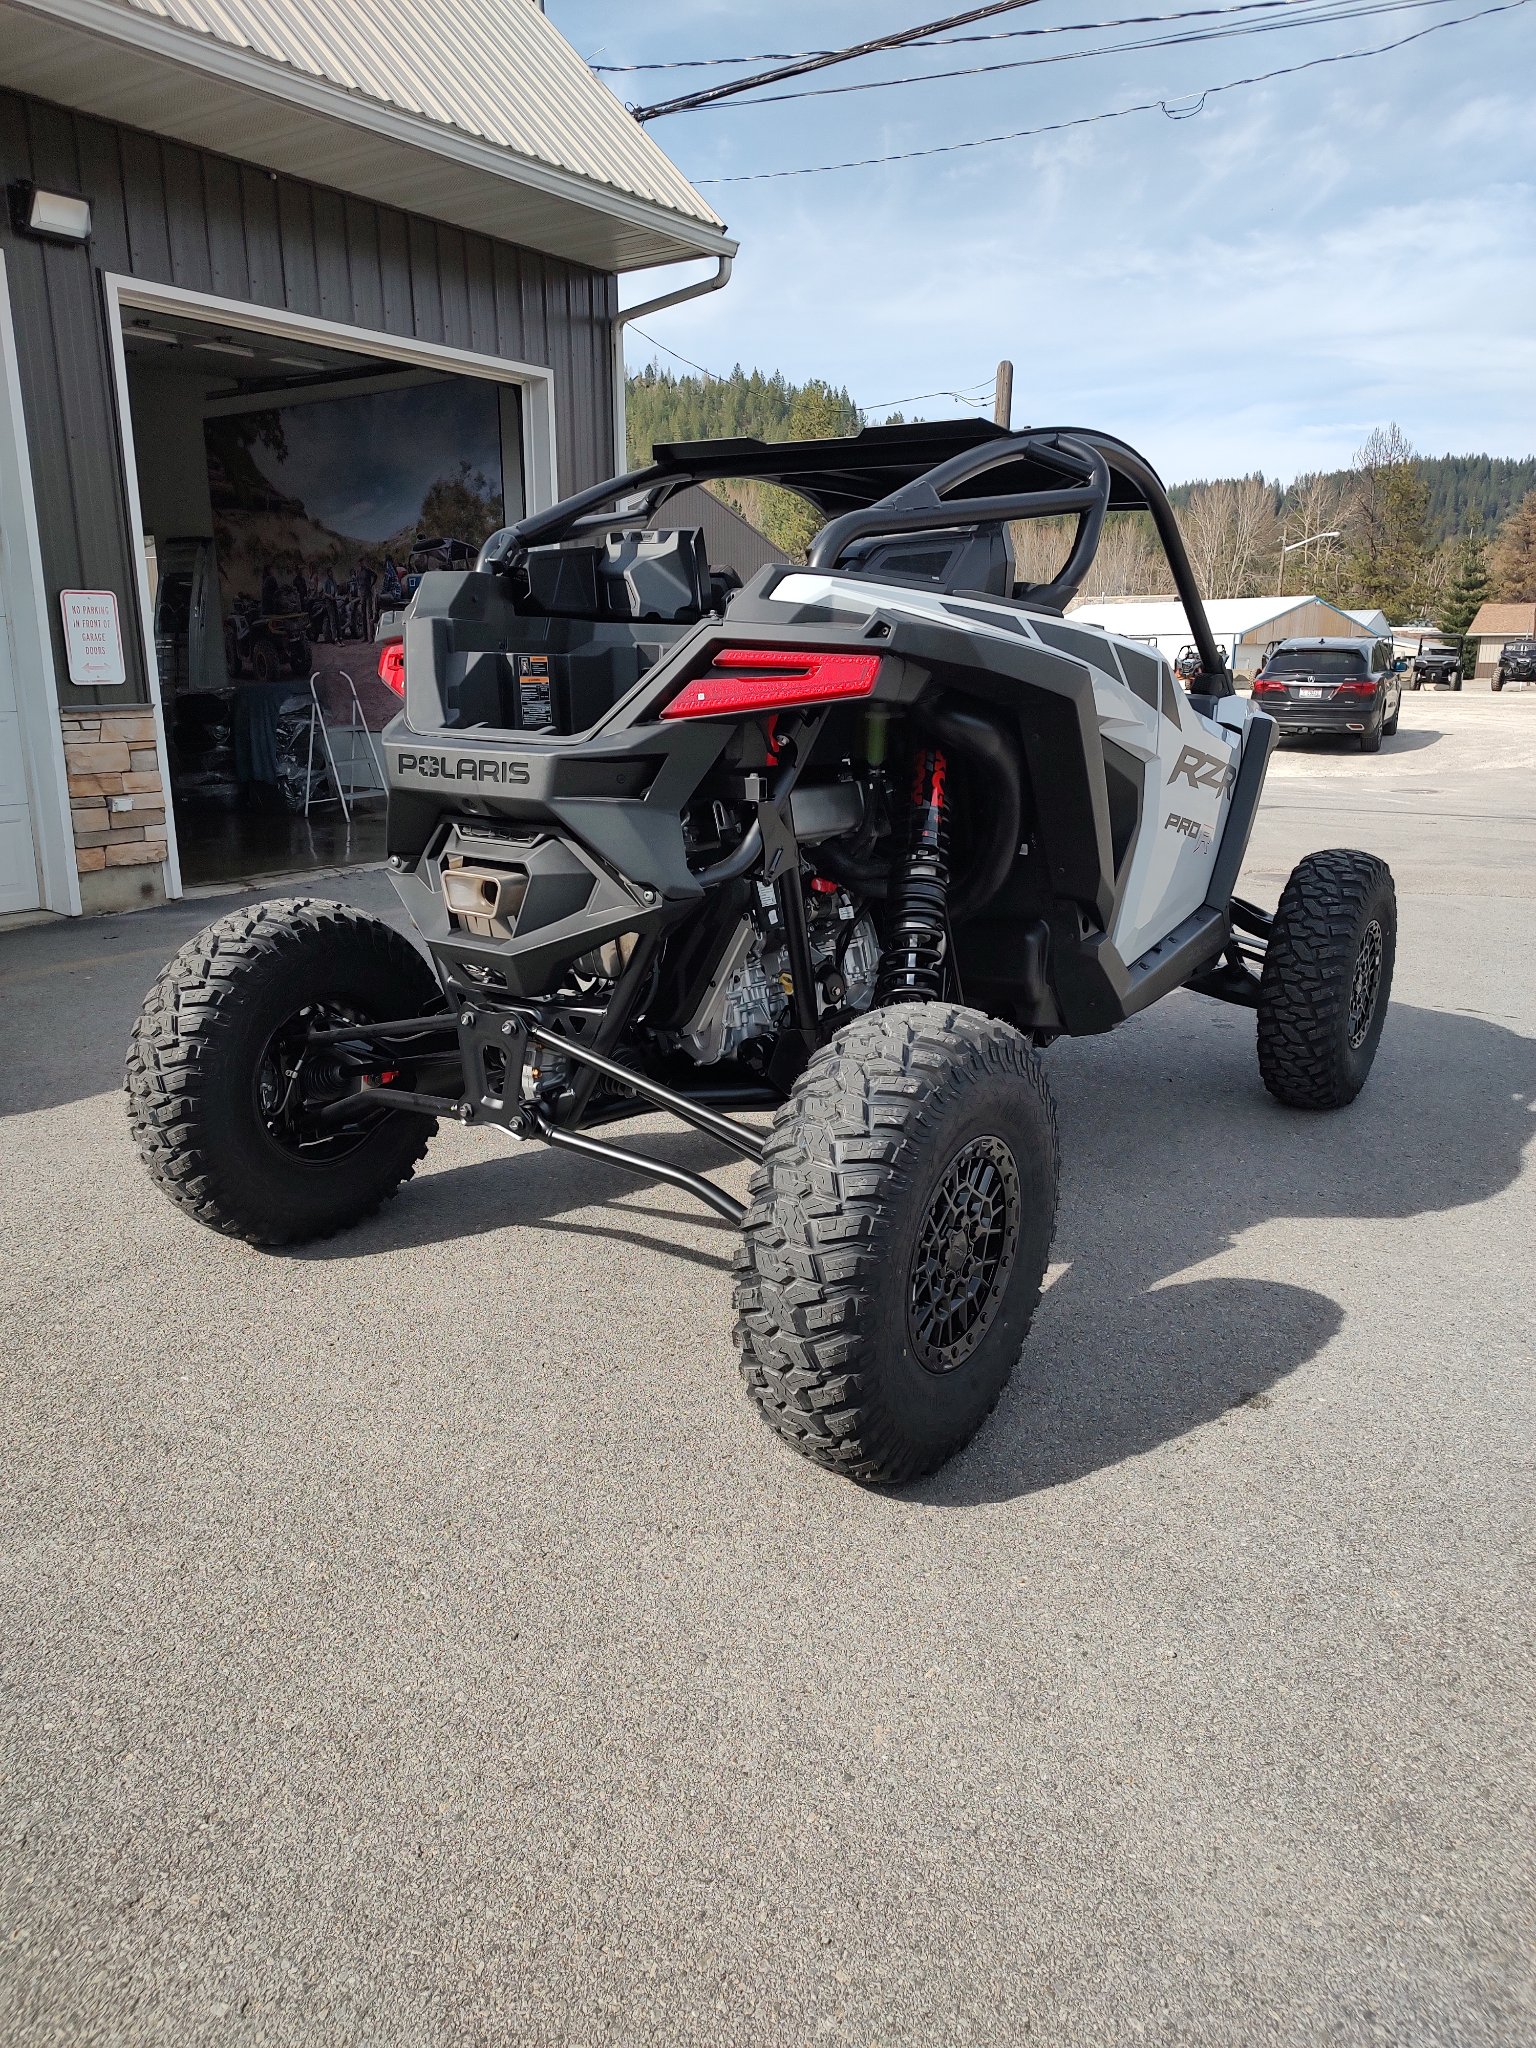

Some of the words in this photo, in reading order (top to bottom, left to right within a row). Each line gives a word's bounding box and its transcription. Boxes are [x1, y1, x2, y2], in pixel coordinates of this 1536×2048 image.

[72, 605, 81, 615] NO
[83, 605, 110, 615] PARKING
[73, 620, 80, 628] IN
[82, 620, 102, 628] FRONT
[103, 620, 111, 628] OF
[81, 633, 106, 642] GARAGE
[85, 646, 106, 655] DOORS
[398, 753, 531, 785] POLARIS
[1166, 744, 1237, 801] RZR
[1164, 812, 1201, 839] PRO
